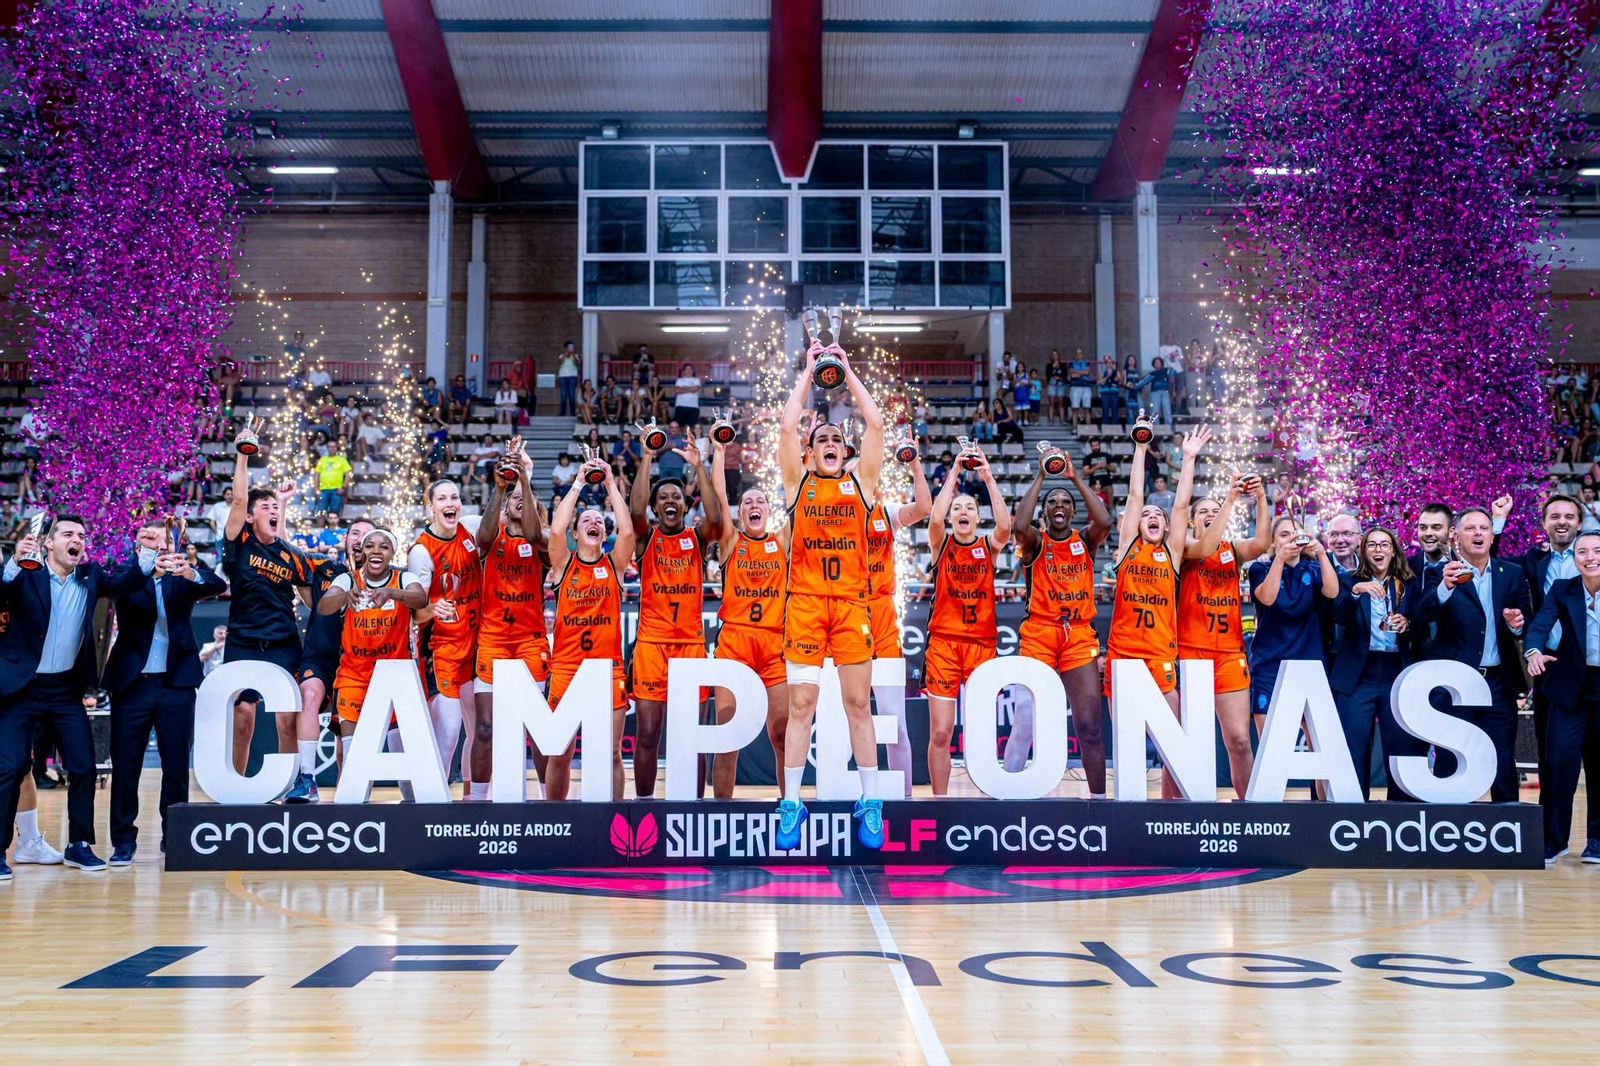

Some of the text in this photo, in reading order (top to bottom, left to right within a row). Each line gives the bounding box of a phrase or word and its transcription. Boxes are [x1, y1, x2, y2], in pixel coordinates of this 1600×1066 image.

[803, 505, 856, 518] VALENCIA
[803, 537, 857, 550] Vitaldin
[249, 554, 293, 581] VALENCIA
[737, 560, 781, 571] VALENCIA
[821, 556, 841, 581] 10
[947, 562, 988, 574] VALENCIA
[1046, 563, 1088, 574] VAENCIA
[1125, 564, 1170, 580] VALENCIA
[566, 587, 611, 599] VALENCIA
[652, 582, 697, 595] Vitaldin
[734, 586, 780, 598] Vitaldin
[1122, 590, 1169, 607] Vitaldin
[1195, 593, 1239, 607] Vitaldin
[502, 607, 515, 626] 4
[669, 602, 680, 622] 7
[750, 602, 763, 623] 8
[961, 604, 979, 624] 13
[1133, 608, 1156, 629] 70
[353, 615, 398, 629] VALENCIA
[563, 615, 612, 627] Vitaldin
[1206, 612, 1230, 634] 75
[580, 630, 593, 651] 6
[193, 655, 1498, 805] CAMPEONAS
[190, 811, 386, 855] endesa
[425, 820, 571, 837] TORREJÓN DE ARDOZ
[879, 818, 937, 852] LF
[945, 816, 1107, 852] endesa
[1145, 819, 1291, 836] TORREJÓN DE ARDOZ
[1329, 811, 1522, 853] endesa
[478, 840, 518, 854] 2026
[1199, 839, 1239, 853] 2026
[58, 945, 520, 989] LF
